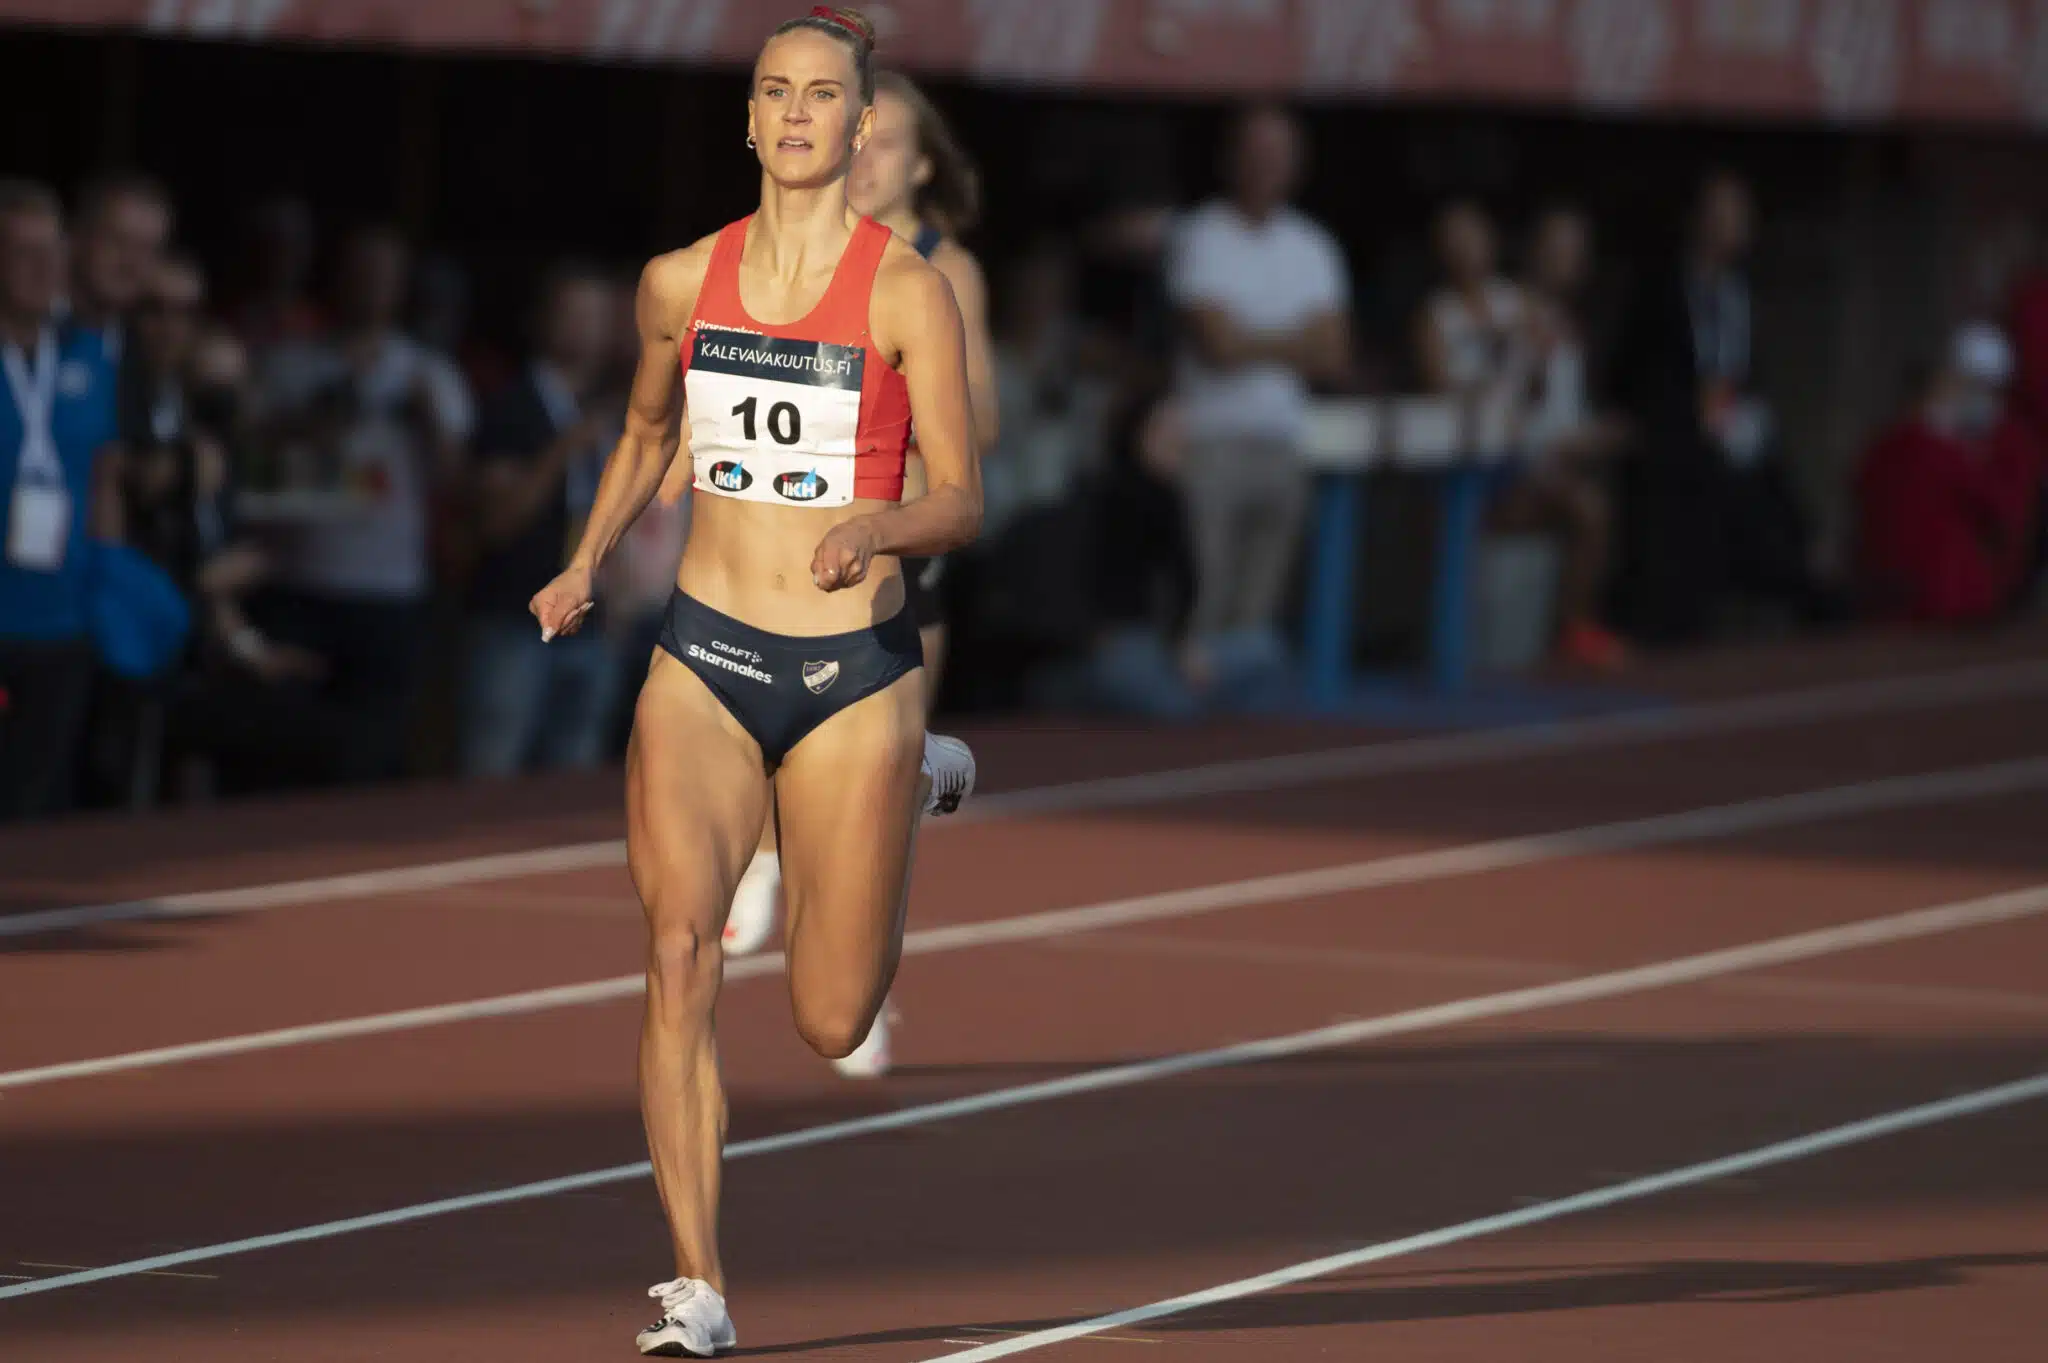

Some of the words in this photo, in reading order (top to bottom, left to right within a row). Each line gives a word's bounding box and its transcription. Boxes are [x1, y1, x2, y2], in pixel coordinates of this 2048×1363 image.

[701, 342, 851, 376] KALEVAVAKUUTUS.FI
[731, 396, 801, 446] 10
[688, 643, 773, 685] Starmakes
[711, 640, 752, 660] CRAFT
